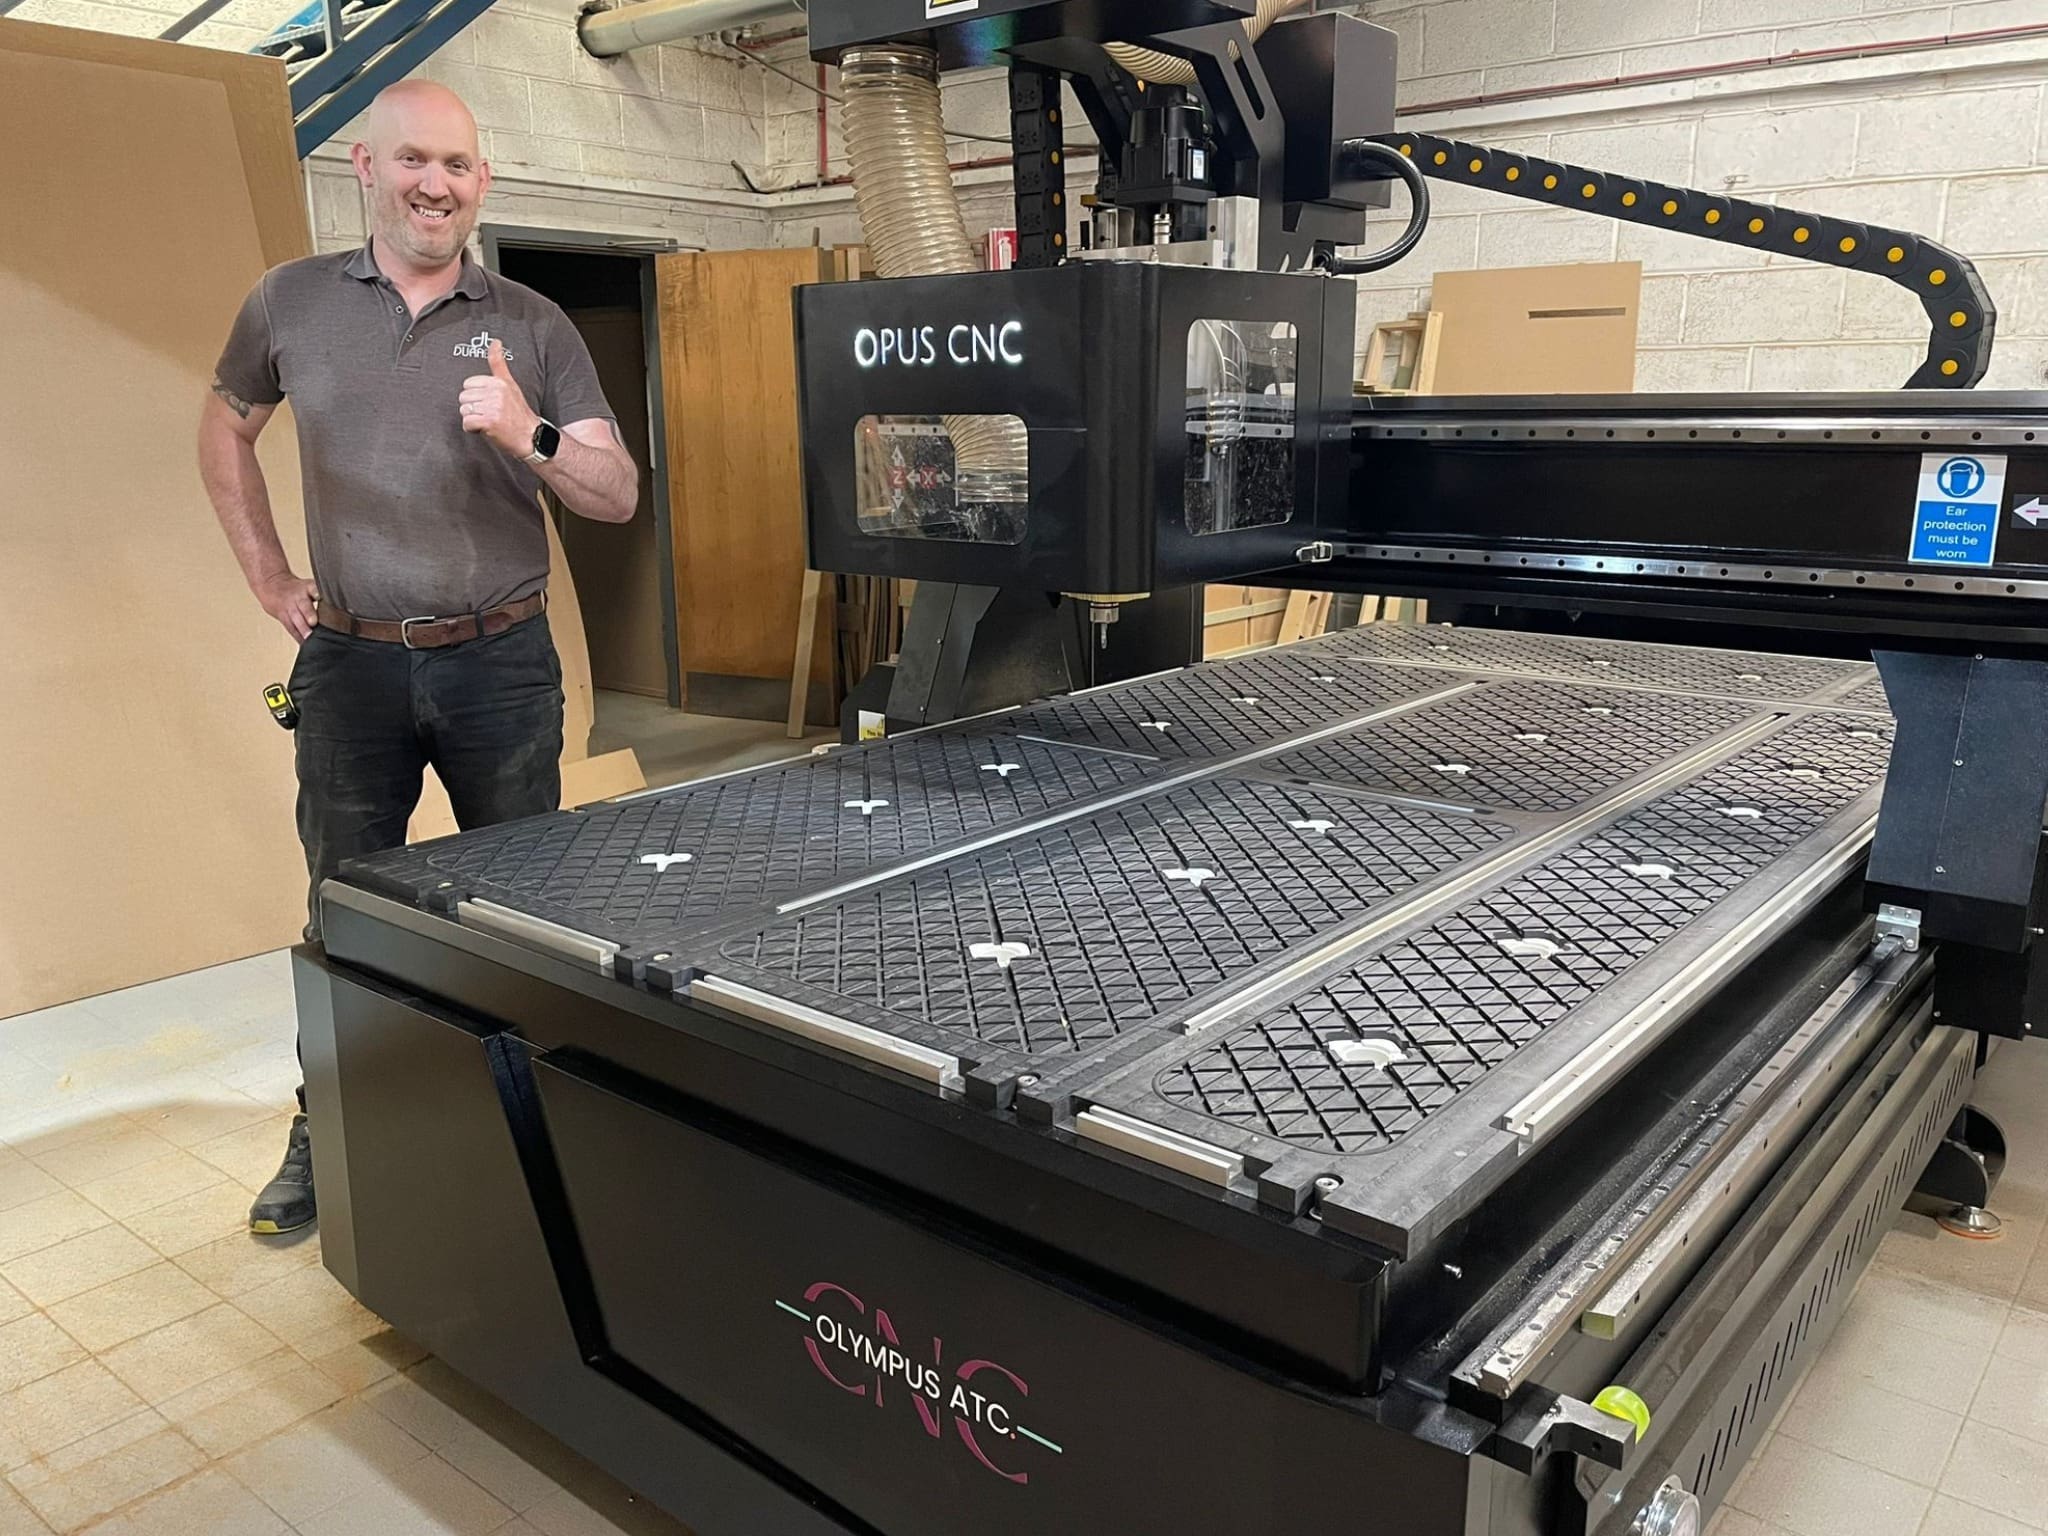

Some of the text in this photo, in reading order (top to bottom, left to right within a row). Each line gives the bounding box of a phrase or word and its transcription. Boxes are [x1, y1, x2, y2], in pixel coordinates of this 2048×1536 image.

[854, 320, 1023, 368] OPUS CNC
[1946, 506, 1967, 516] Ear
[1923, 520, 1986, 532] protection
[1928, 535, 1978, 546] must be
[1936, 550, 1967, 559] worn
[816, 1314, 940, 1400] OLYMPUS
